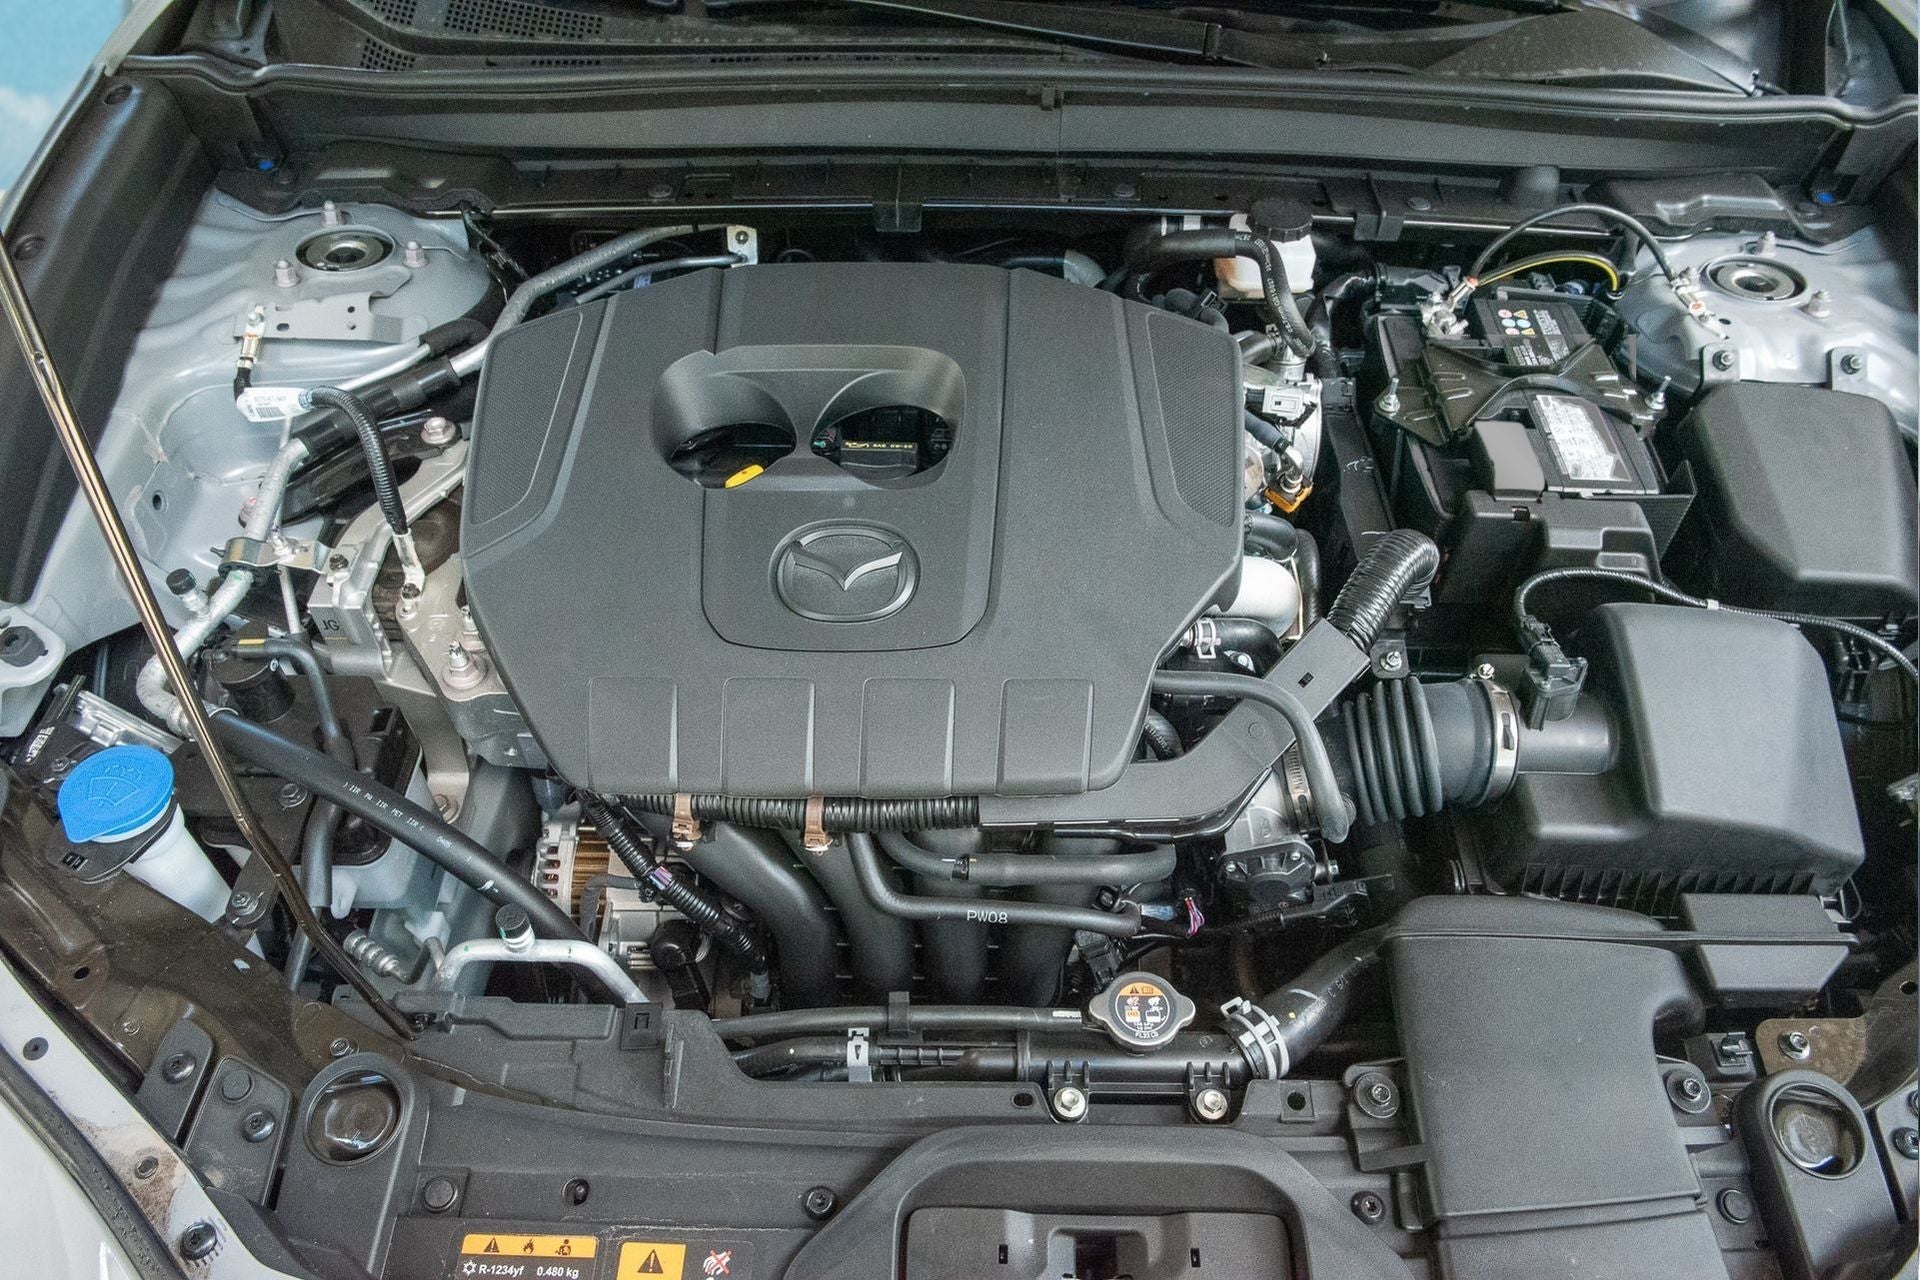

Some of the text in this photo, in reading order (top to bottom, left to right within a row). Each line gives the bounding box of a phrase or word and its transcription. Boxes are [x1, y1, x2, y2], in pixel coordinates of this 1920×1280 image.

[966, 909, 1008, 924] PW08
[478, 1264, 579, 1279] R-1234yf 0.480 kg
